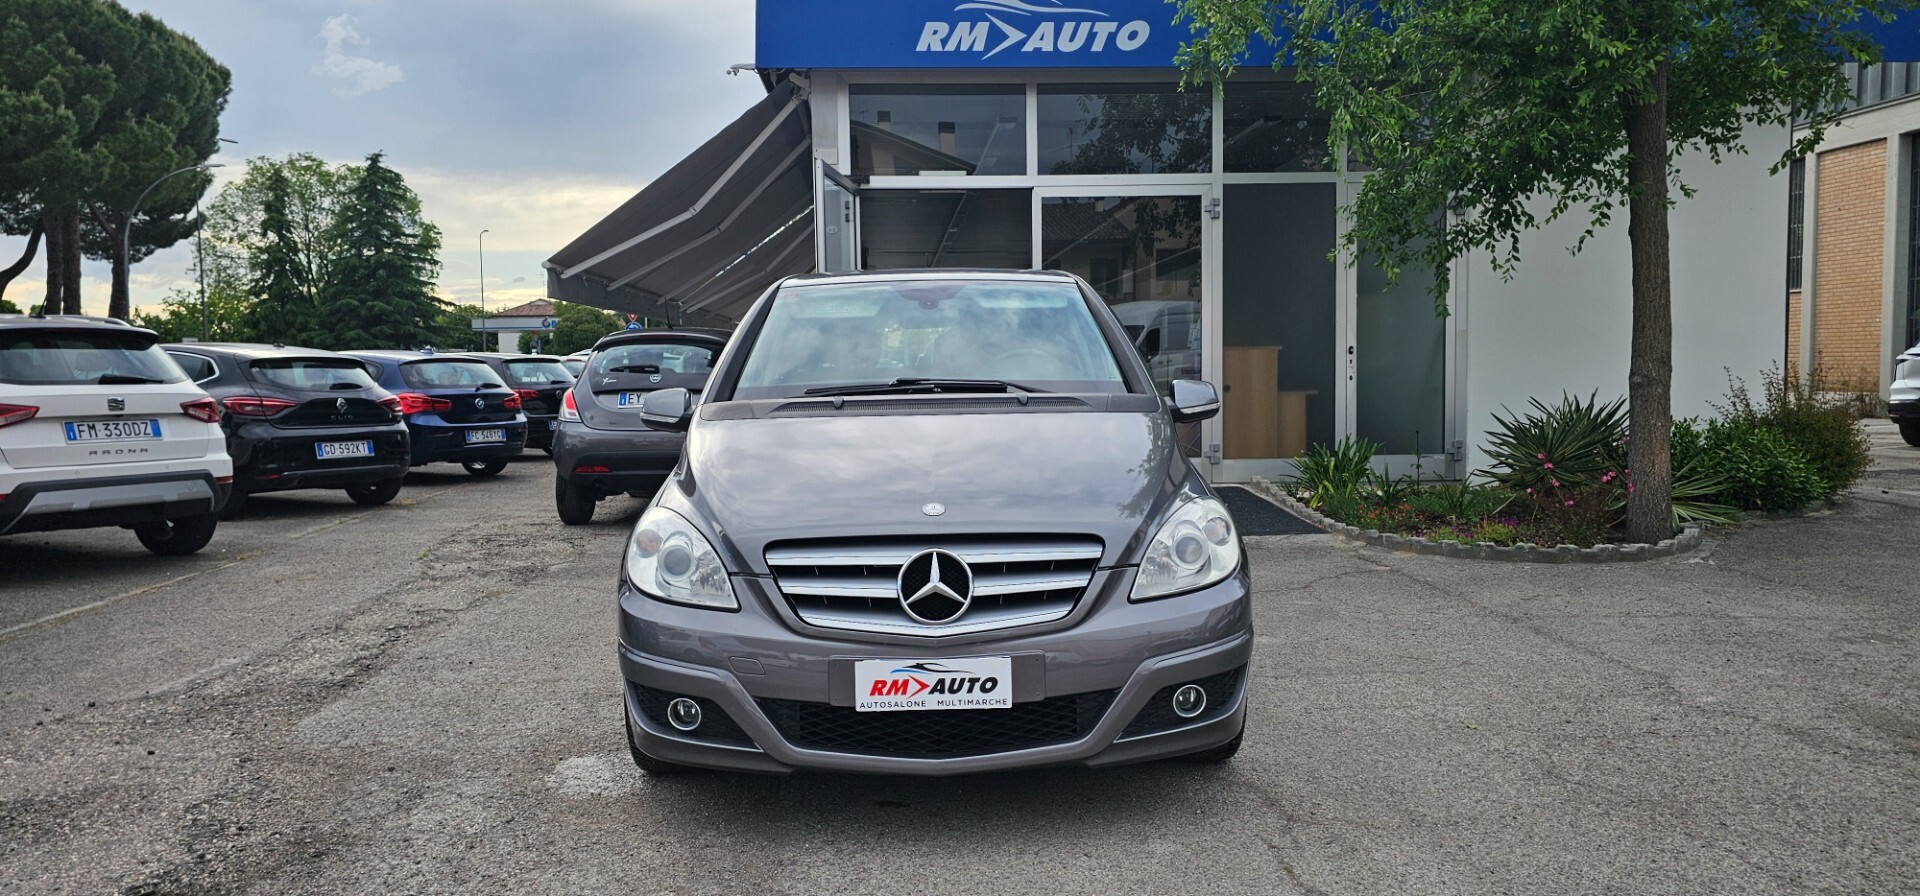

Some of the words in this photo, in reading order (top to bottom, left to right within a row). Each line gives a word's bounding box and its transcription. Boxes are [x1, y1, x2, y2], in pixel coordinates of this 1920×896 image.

[915, 21, 990, 52] RM
[1021, 20, 1151, 52] AUTO
[88, 447, 149, 456] ARONA
[869, 678, 910, 697] RM
[928, 676, 999, 696] AUTO
[859, 699, 927, 709] AUTOSALONE
[937, 698, 1008, 707] MULTIMARCHE
